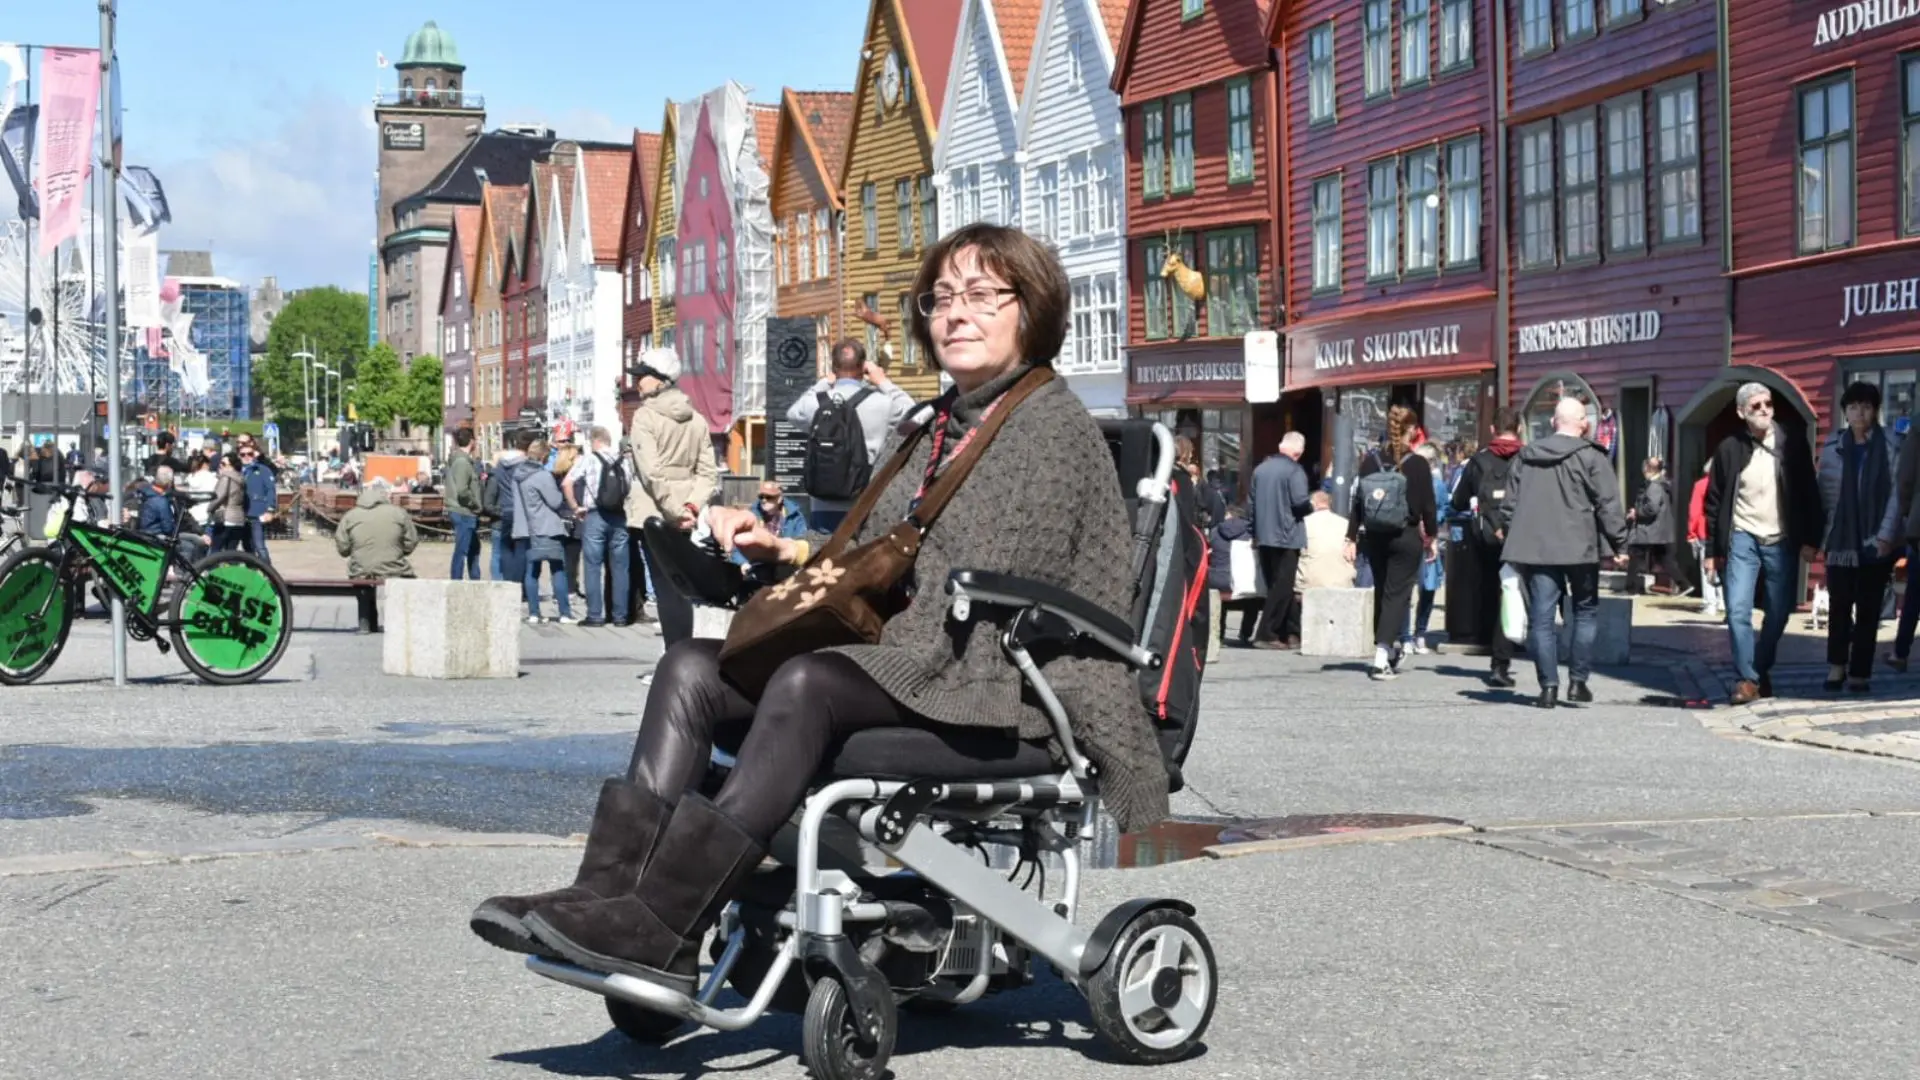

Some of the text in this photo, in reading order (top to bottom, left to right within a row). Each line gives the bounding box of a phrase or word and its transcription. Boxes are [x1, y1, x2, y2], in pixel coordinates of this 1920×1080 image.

[1840, 278, 1920, 327] JULEH
[1315, 324, 1460, 370] KNUT SKURTVEIT
[1519, 309, 1660, 353] BRYGGEN HUSFLID
[1136, 364, 1183, 384] BRYGGEN
[202, 582, 276, 626] BASE
[192, 611, 267, 648] CAMP
